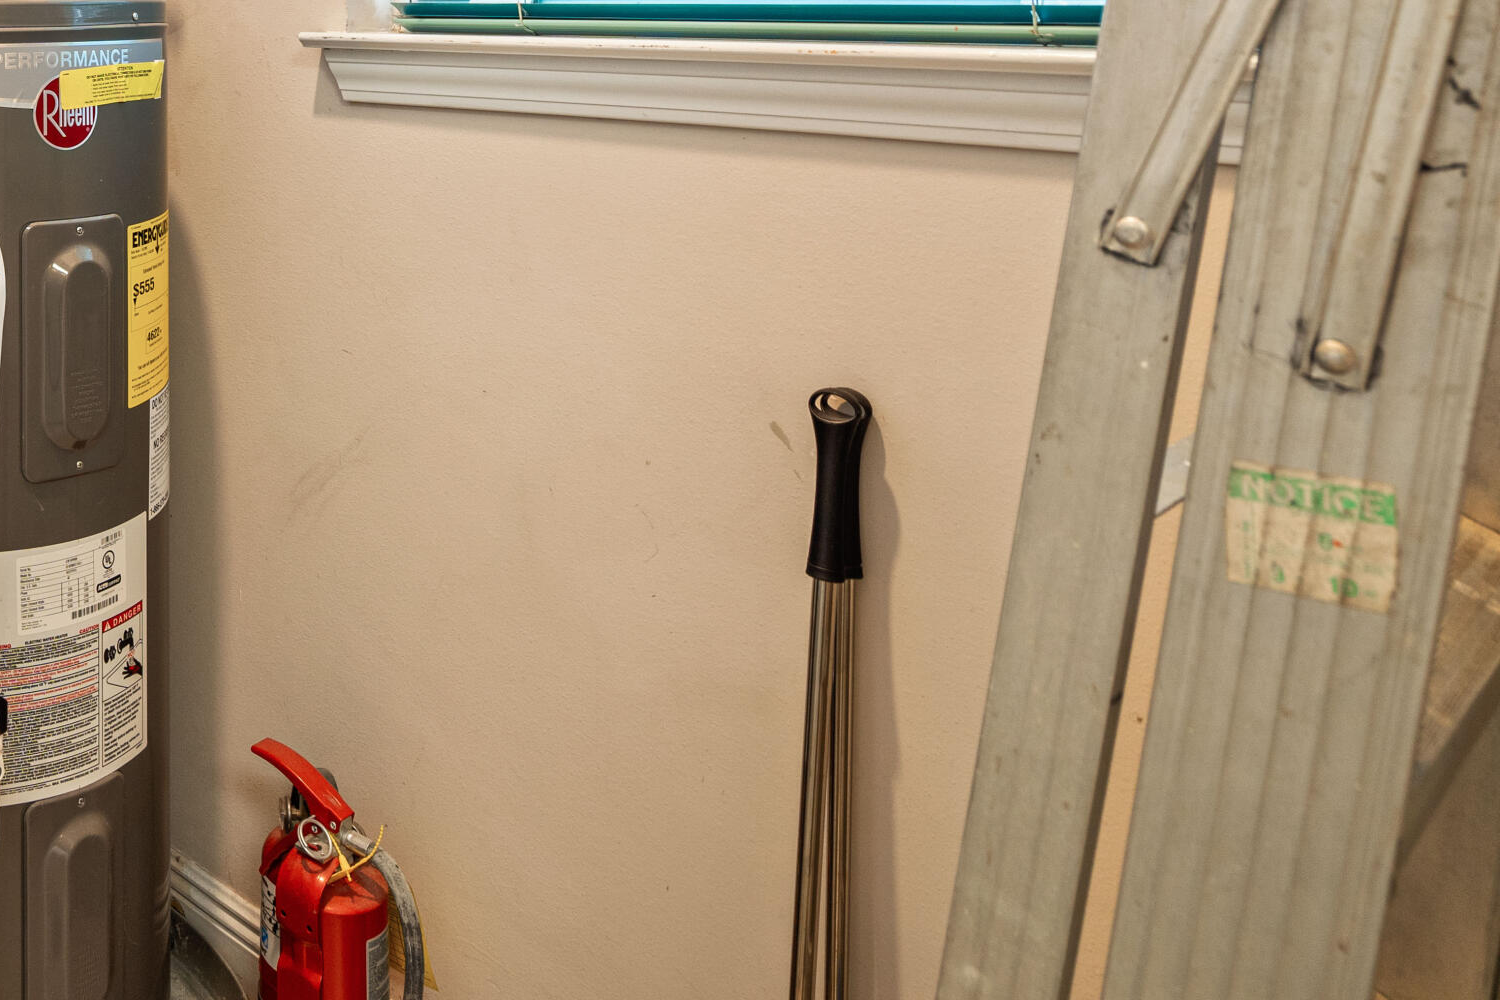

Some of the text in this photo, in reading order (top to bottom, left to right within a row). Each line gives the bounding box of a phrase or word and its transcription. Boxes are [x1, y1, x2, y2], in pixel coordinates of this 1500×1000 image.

[1241, 474, 1383, 521] NOTICE
[112, 604, 141, 627] DANGER
[79, 624, 99, 634] CAUTION
